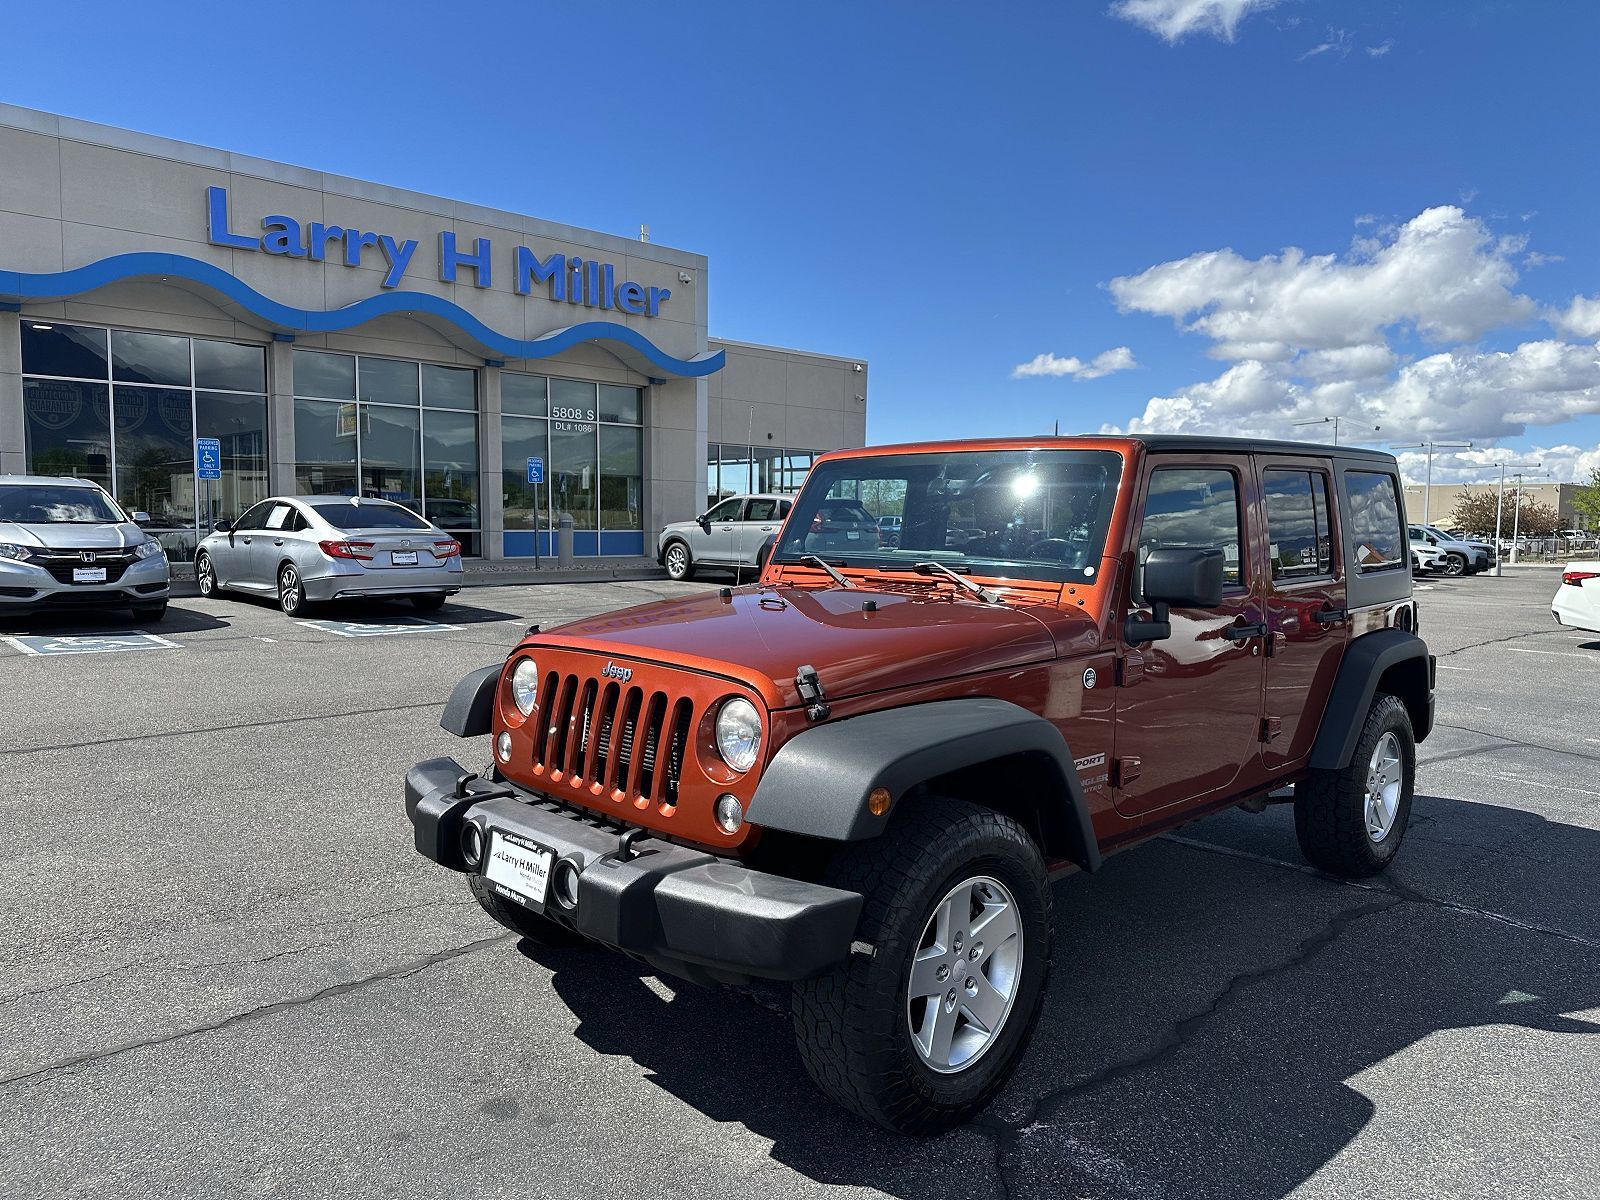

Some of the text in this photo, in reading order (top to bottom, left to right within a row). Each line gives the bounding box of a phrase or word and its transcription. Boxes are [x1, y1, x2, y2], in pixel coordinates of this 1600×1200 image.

[206, 186, 671, 318] Larry H Miller
[30, 390, 75, 401] PROTECTION
[30, 401, 76, 413] GUARANTEE
[552, 406, 595, 421] 5808 S
[555, 422, 571, 431] DL#
[602, 661, 633, 684] Jeep
[1074, 755, 1105, 769] PORT
[1080, 774, 1109, 787] NGLER
[502, 850, 547, 878] Larry H Miller
[495, 883, 511, 898] Honda
